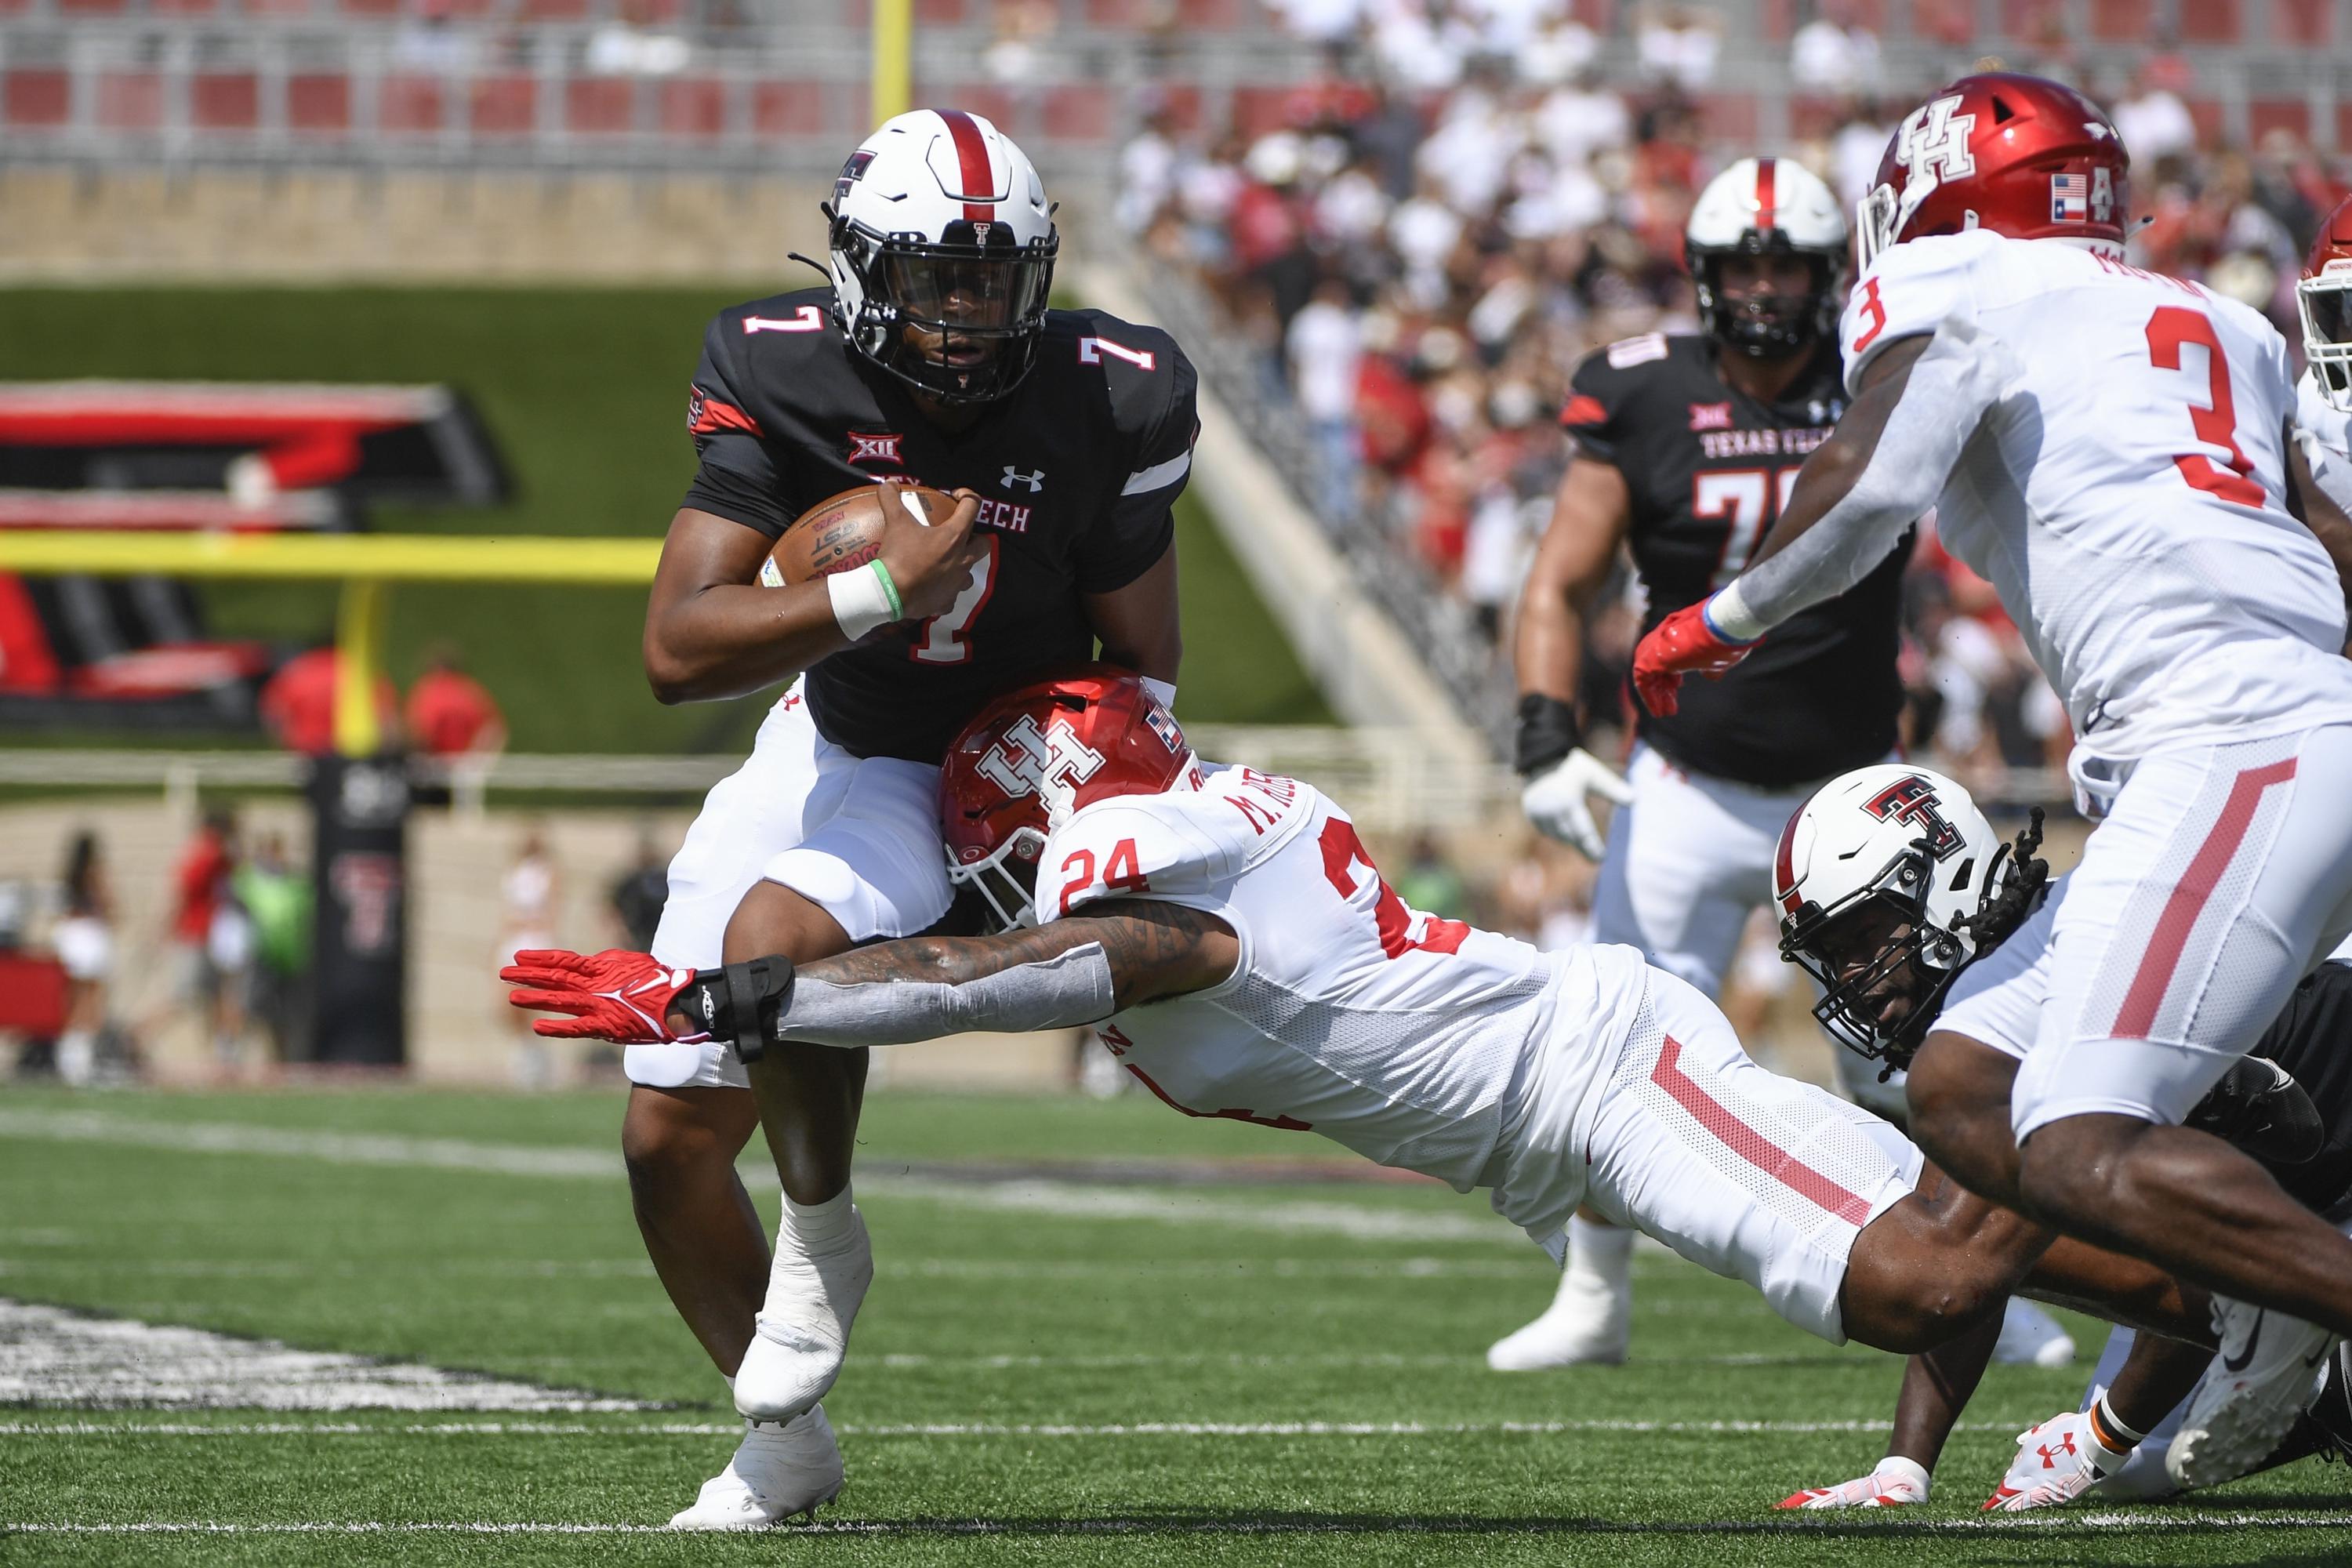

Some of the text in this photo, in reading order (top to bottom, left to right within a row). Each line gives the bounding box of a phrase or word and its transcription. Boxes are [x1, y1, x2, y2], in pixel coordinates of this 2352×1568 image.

[742, 304, 824, 335] 7
[1078, 336, 1156, 371] 7
[1853, 276, 1886, 354] 3
[2146, 306, 2267, 509] 3
[975, 499, 1031, 533] ECH
[1693, 465, 1805, 579] 7
[1059, 838, 1150, 916] 24
